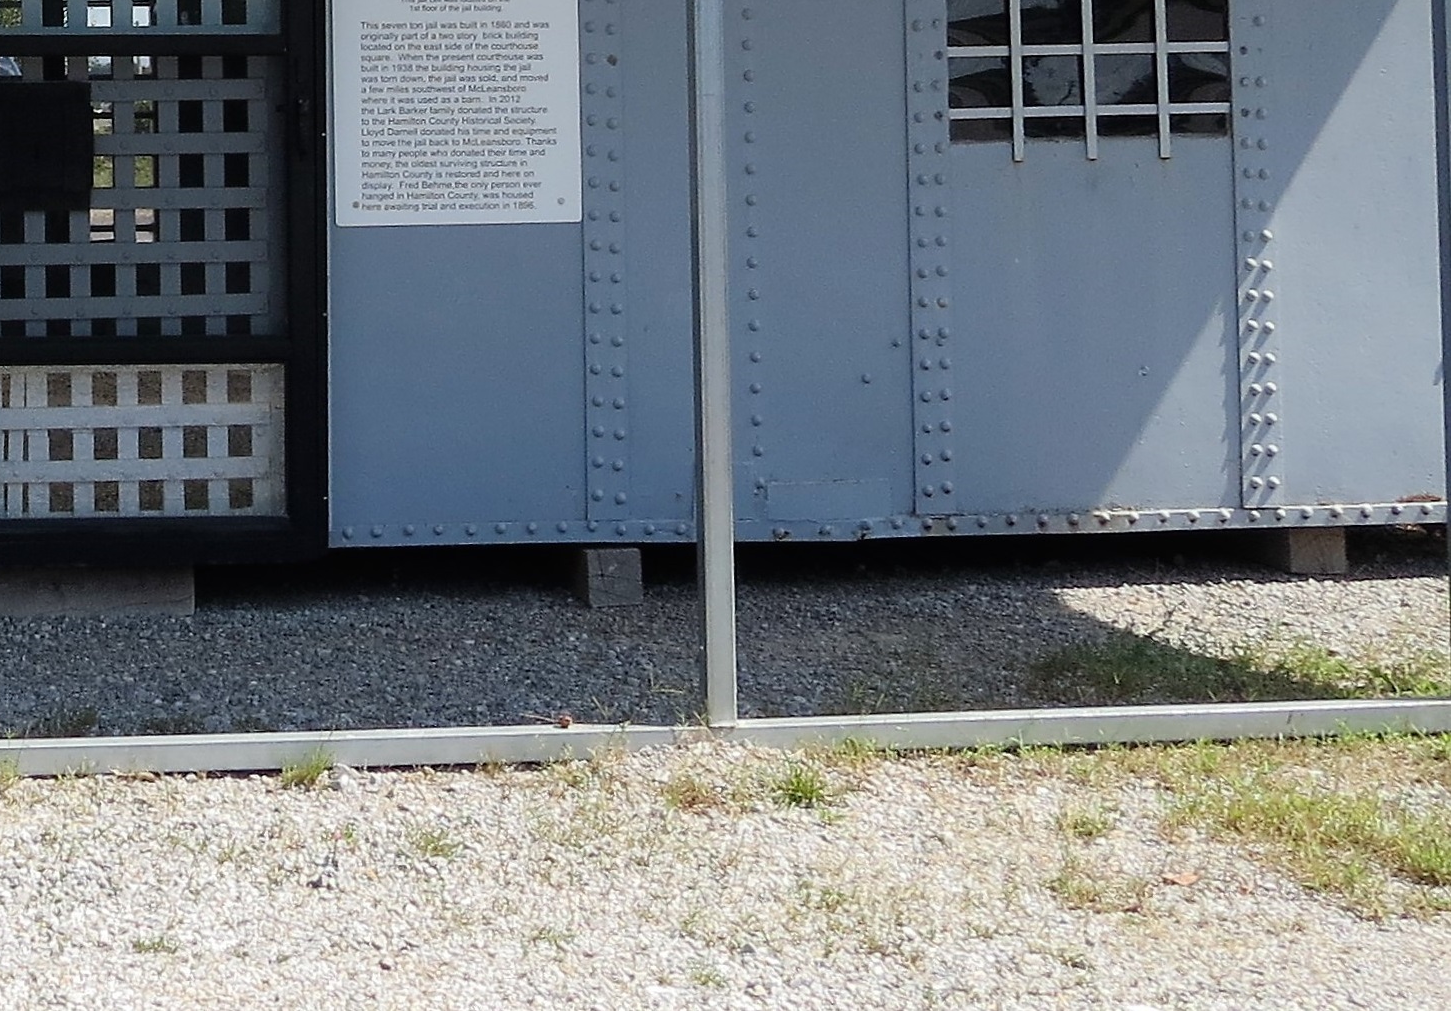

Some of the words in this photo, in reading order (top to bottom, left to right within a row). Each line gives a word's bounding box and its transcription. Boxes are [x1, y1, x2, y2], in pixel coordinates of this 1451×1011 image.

[461, 5, 472, 13] jail
[425, 21, 438, 30] jail
[514, 20, 530, 28] and
[360, 32, 399, 41] originally
[401, 33, 418, 41] part
[482, 31, 503, 39] brick
[505, 31, 539, 40] building
[407, 42, 421, 50] the
[445, 42, 462, 50] side
[464, 42, 473, 50] of
[475, 42, 489, 50] the
[397, 53, 424, 61] When
[426, 53, 440, 61] the
[442, 54, 475, 62] present
[361, 64, 379, 72] built
[392, 64, 413, 72] 1938
[415, 64, 429, 72] the
[431, 64, 465, 73] building
[467, 64, 501, 73] housing
[518, 64, 531, 73] jail
[399, 75, 426, 83] down,
[428, 74, 442, 82] the
[444, 74, 457, 84] jail
[501, 74, 518, 82] and
[369, 85, 384, 93] few
[386, 85, 409, 93] miles
[412, 85, 456, 93] southwest
[361, 96, 388, 104] where
[417, 96, 439, 104] used
[429, 106, 455, 116] family
[457, 106, 492, 114] donated
[495, 106, 508, 114] the
[428, 117, 460, 127] County
[461, 117, 501, 125] Historical
[361, 128, 385, 137] Lloyd
[387, 128, 418, 136] Darnell
[511, 128, 557, 136] equipment
[397, 138, 412, 146] the
[414, 138, 427, 148] jail
[429, 138, 449, 146] back
[372, 151, 396, 159] many
[398, 149, 428, 158] people
[430, 149, 448, 157] who
[439, 160, 477, 169] surviving
[362, 170, 400, 178] Hamilton
[402, 170, 433, 179] County
[445, 170, 481, 178] restored
[399, 181, 419, 189] Fred
[470, 181, 489, 190] only
[491, 182, 521, 190] person
[362, 192, 394, 201] hanged
[502, 191, 533, 199] housed
[384, 203, 419, 212] awaiting
[421, 202, 438, 210] trial
[440, 202, 456, 210] and
